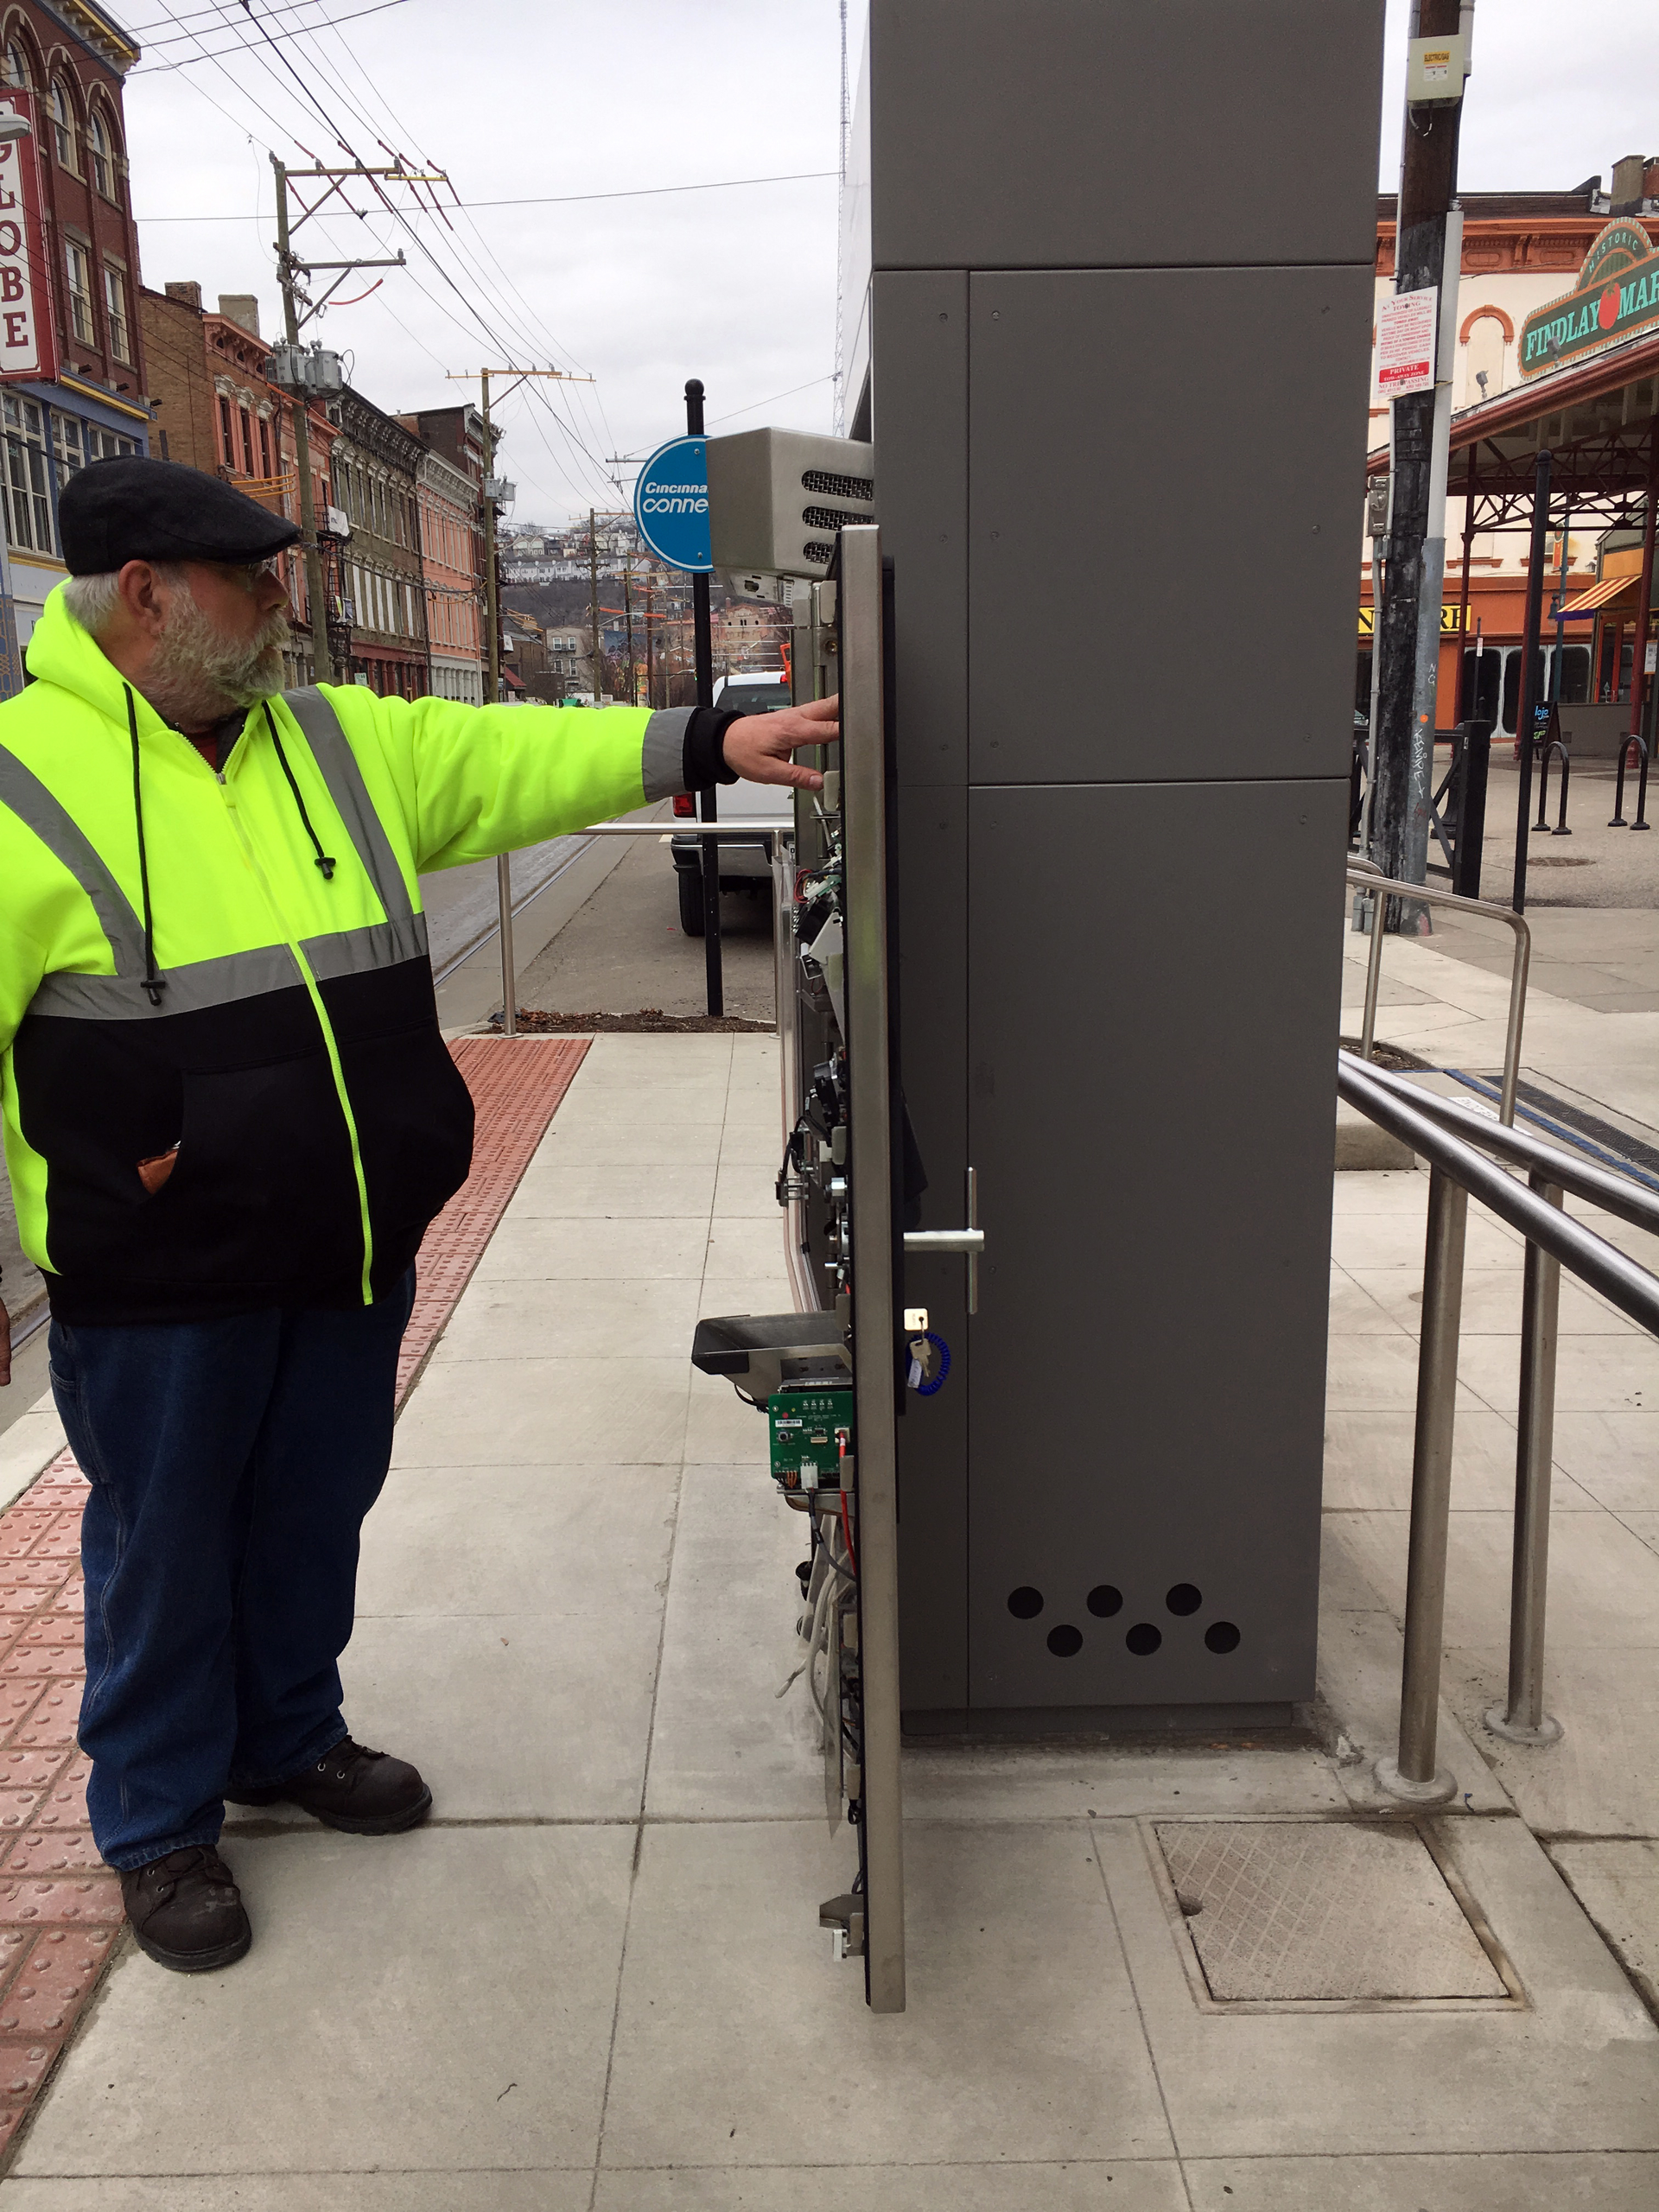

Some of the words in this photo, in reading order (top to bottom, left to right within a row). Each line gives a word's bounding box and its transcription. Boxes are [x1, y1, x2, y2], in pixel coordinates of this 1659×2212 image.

[0, 143, 29, 347] LOBE
[1589, 232, 1638, 273] HISTORIC
[1526, 299, 1601, 361] FINDLAY
[1390, 364, 1419, 374] PRIVATE
[1390, 376, 1429, 387] TREPASSING
[645, 482, 708, 494] Cincinna
[642, 498, 709, 513] conne
